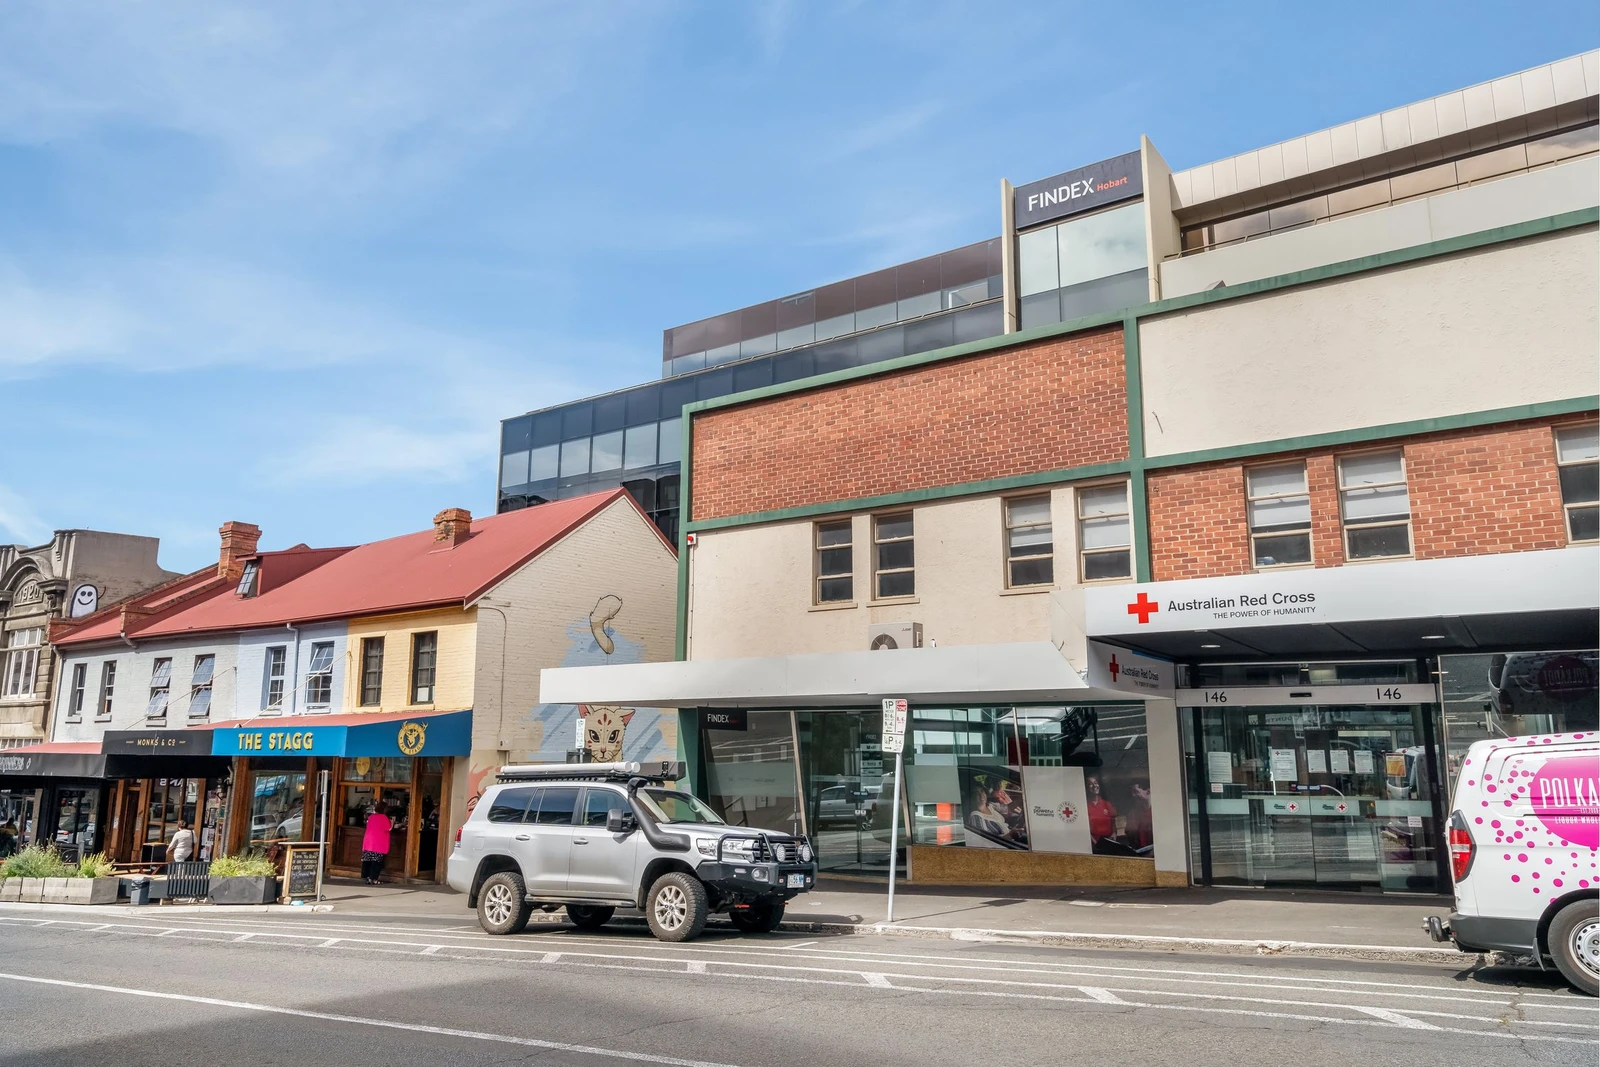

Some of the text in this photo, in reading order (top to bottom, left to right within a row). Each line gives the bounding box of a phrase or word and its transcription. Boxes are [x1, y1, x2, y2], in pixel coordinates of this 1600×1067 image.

[1028, 176, 1128, 211] FINDEX Hobart
[1168, 592, 1316, 612] Australian Red Cross
[1213, 606, 1317, 620] THE POWER OF HUMANITY
[1205, 691, 1228, 703] 146
[1377, 687, 1402, 701] 146
[884, 700, 894, 709] 1P
[707, 713, 730, 724] FINDEX
[238, 732, 314, 751] THE STAGG
[1540, 777, 1599, 809] POLKA
[1554, 816, 1579, 824] LIQUOR
